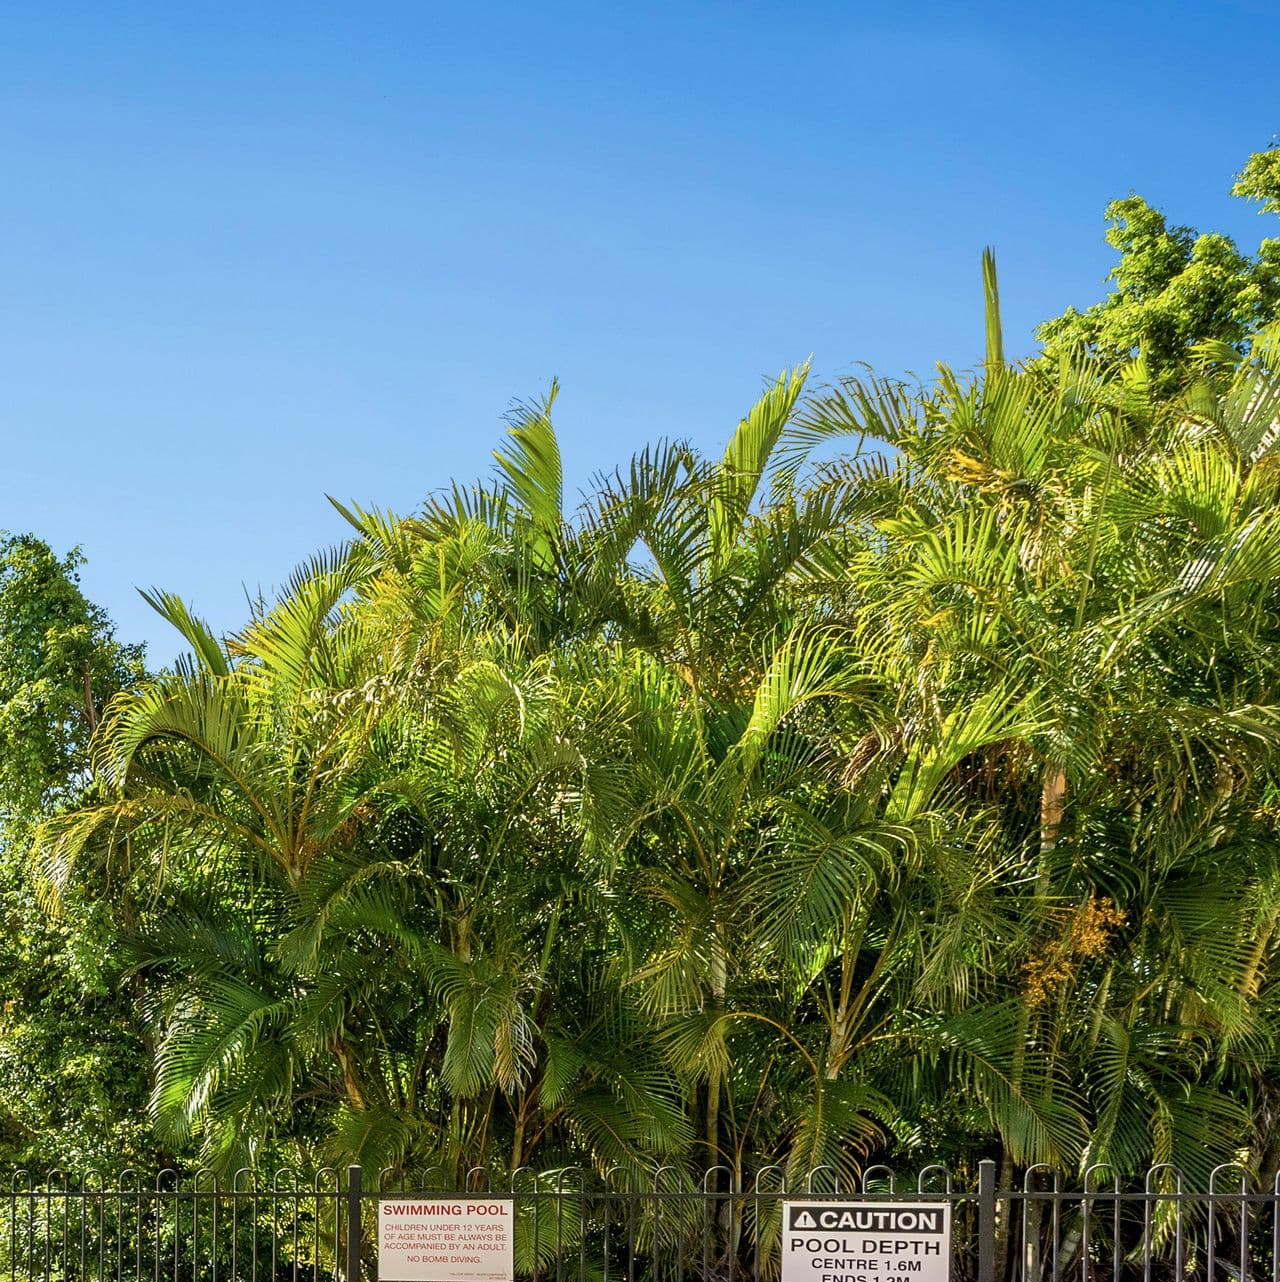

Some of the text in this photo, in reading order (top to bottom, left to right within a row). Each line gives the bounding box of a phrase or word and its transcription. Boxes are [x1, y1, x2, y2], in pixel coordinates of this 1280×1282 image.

[383, 1205, 508, 1216] SWIMMING POOL
[820, 1211, 937, 1230] CAUTION
[430, 1224, 460, 1232] UNDER
[463, 1224, 473, 1232] 12
[475, 1224, 504, 1232] YEARS
[384, 1233, 507, 1241] OF AGE MUST BE ALWAYS BE
[384, 1242, 446, 1250] ACCOMPANIED
[791, 1238, 940, 1255] POOL DEPTH
[407, 1255, 420, 1263] NO
[422, 1255, 448, 1263] BOMB
[811, 1258, 921, 1272] CENTRE 1.6M
